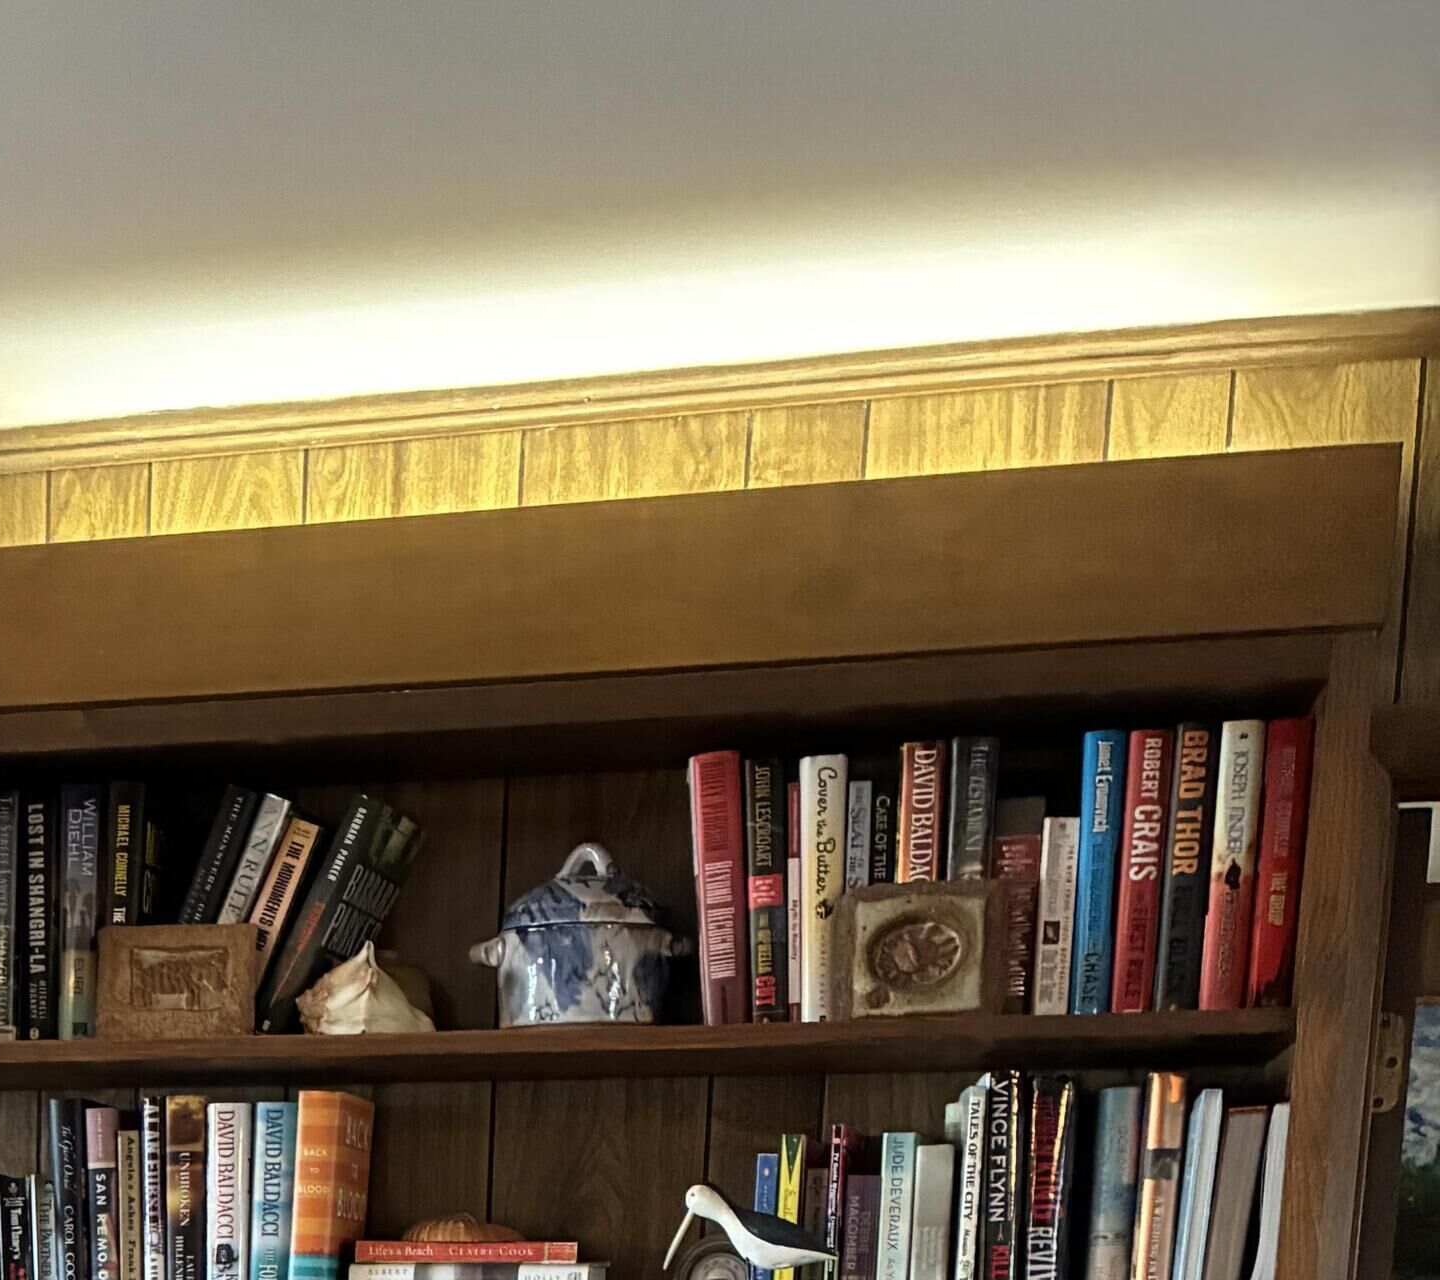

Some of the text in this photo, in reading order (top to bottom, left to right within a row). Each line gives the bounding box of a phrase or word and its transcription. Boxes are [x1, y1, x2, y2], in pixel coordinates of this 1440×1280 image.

[753, 765, 771, 798] JOHN
[1179, 730, 1209, 799] BRAD
[1231, 750, 1249, 799] JOSEPH
[68, 809, 81, 865] DIEHL
[81, 798, 96, 876] WILLIAM
[755, 801, 773, 867] LESCROART
[816, 767, 838, 895] Cover the Butter
[874, 796, 890, 879] CARE OF THE
[909, 749, 937, 882] DAVID BALDAC
[1129, 737, 1162, 881] ROBERT CRAIS
[1172, 805, 1203, 876] THOR
[113, 805, 130, 923] MICHAEL CONNELLY THE
[327, 807, 368, 882] BARBARA PARKER
[28, 804, 45, 973] LOST IN SHANGRI-LA
[226, 857, 260, 921] RULE
[258, 841, 305, 926] THE MONUMENTS
[706, 907, 736, 979] RECOGNITION
[967, 1143, 978, 1160] OF
[968, 1099, 981, 1140] TALES
[989, 1080, 1010, 1222] VINCE FLYNN
[95, 1173, 107, 1206] SAN
[179, 1152, 191, 1227] UNBROKEN
[216, 1110, 234, 1240] DAVID BALDACCI
[261, 1109, 284, 1237] DAVID BALDACCI
[887, 1136, 907, 1250] JUDE DEVERAUX
[963, 1192, 974, 1220] CITY
[965, 1162, 977, 1188] THE
[39, 1199, 52, 1225] THE
[64, 1205, 74, 1249] CAROL
[96, 1213, 108, 1263] REMO
[127, 1196, 137, 1231] Ashes
[846, 1195, 860, 1270] MACOMBER
[127, 1240, 137, 1273] Frank
[404, 1245, 434, 1257] Beach
[499, 1246, 534, 1257] COOK
[991, 1244, 1009, 1277] KILL
